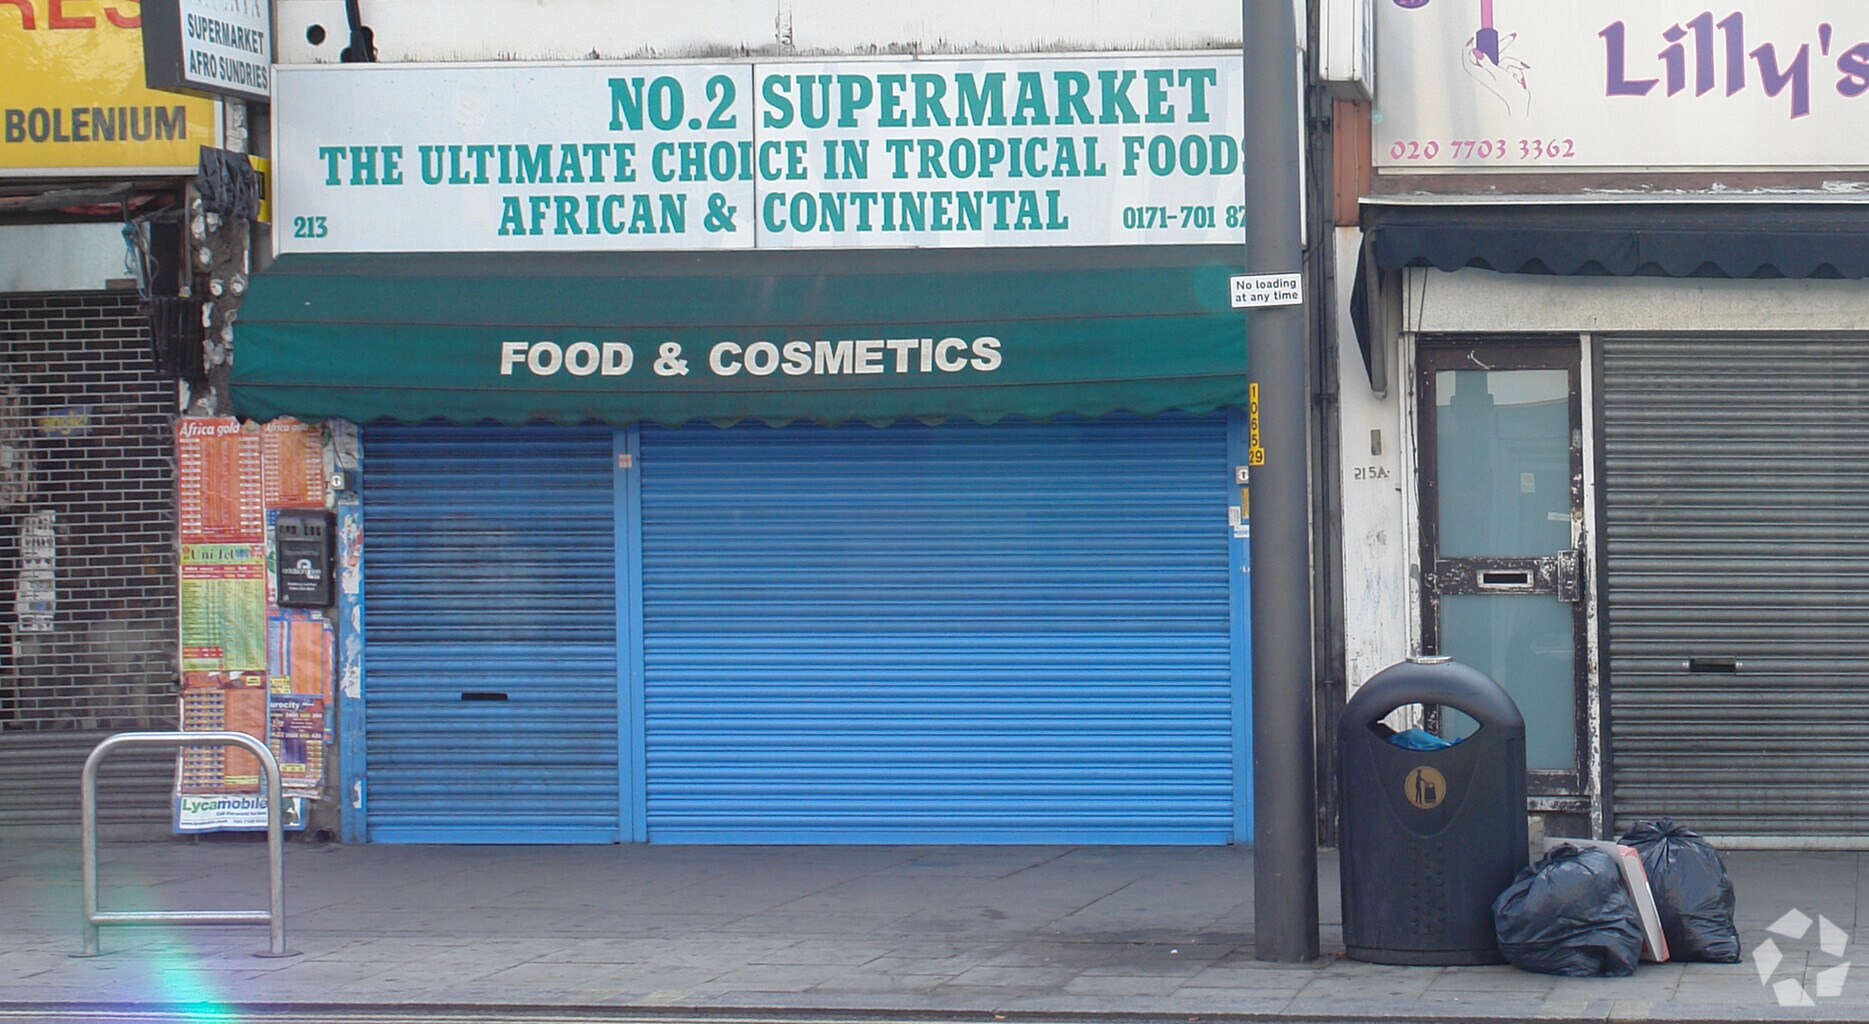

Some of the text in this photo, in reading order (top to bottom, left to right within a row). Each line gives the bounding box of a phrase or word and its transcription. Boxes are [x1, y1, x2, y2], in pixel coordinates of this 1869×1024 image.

[187, 13, 264, 55] SUPERMARKET
[190, 49, 268, 90] AFRO SUNDRIES
[1598, 11, 1869, 120] Lilly's
[608, 68, 1217, 132] NO.2 SUPERMARKET
[5, 105, 187, 144] BOLENIUM
[319, 134, 1246, 186] THE ULTIMATE CHOICE IN TROPICAL FOOD
[1390, 138, 1575, 160] 020 7703 3362
[293, 216, 328, 239] 213
[497, 189, 1069, 237] AFRICAN & CONTINENTAL
[1123, 206, 1216, 229] 0171-701
[1235, 290, 1298, 303] at any time
[1236, 278, 1297, 290] No loading
[500, 336, 1002, 376] FOOD & COSMETICS
[179, 422, 240, 438] Africa gold
[182, 796, 267, 814] Lycamobile
